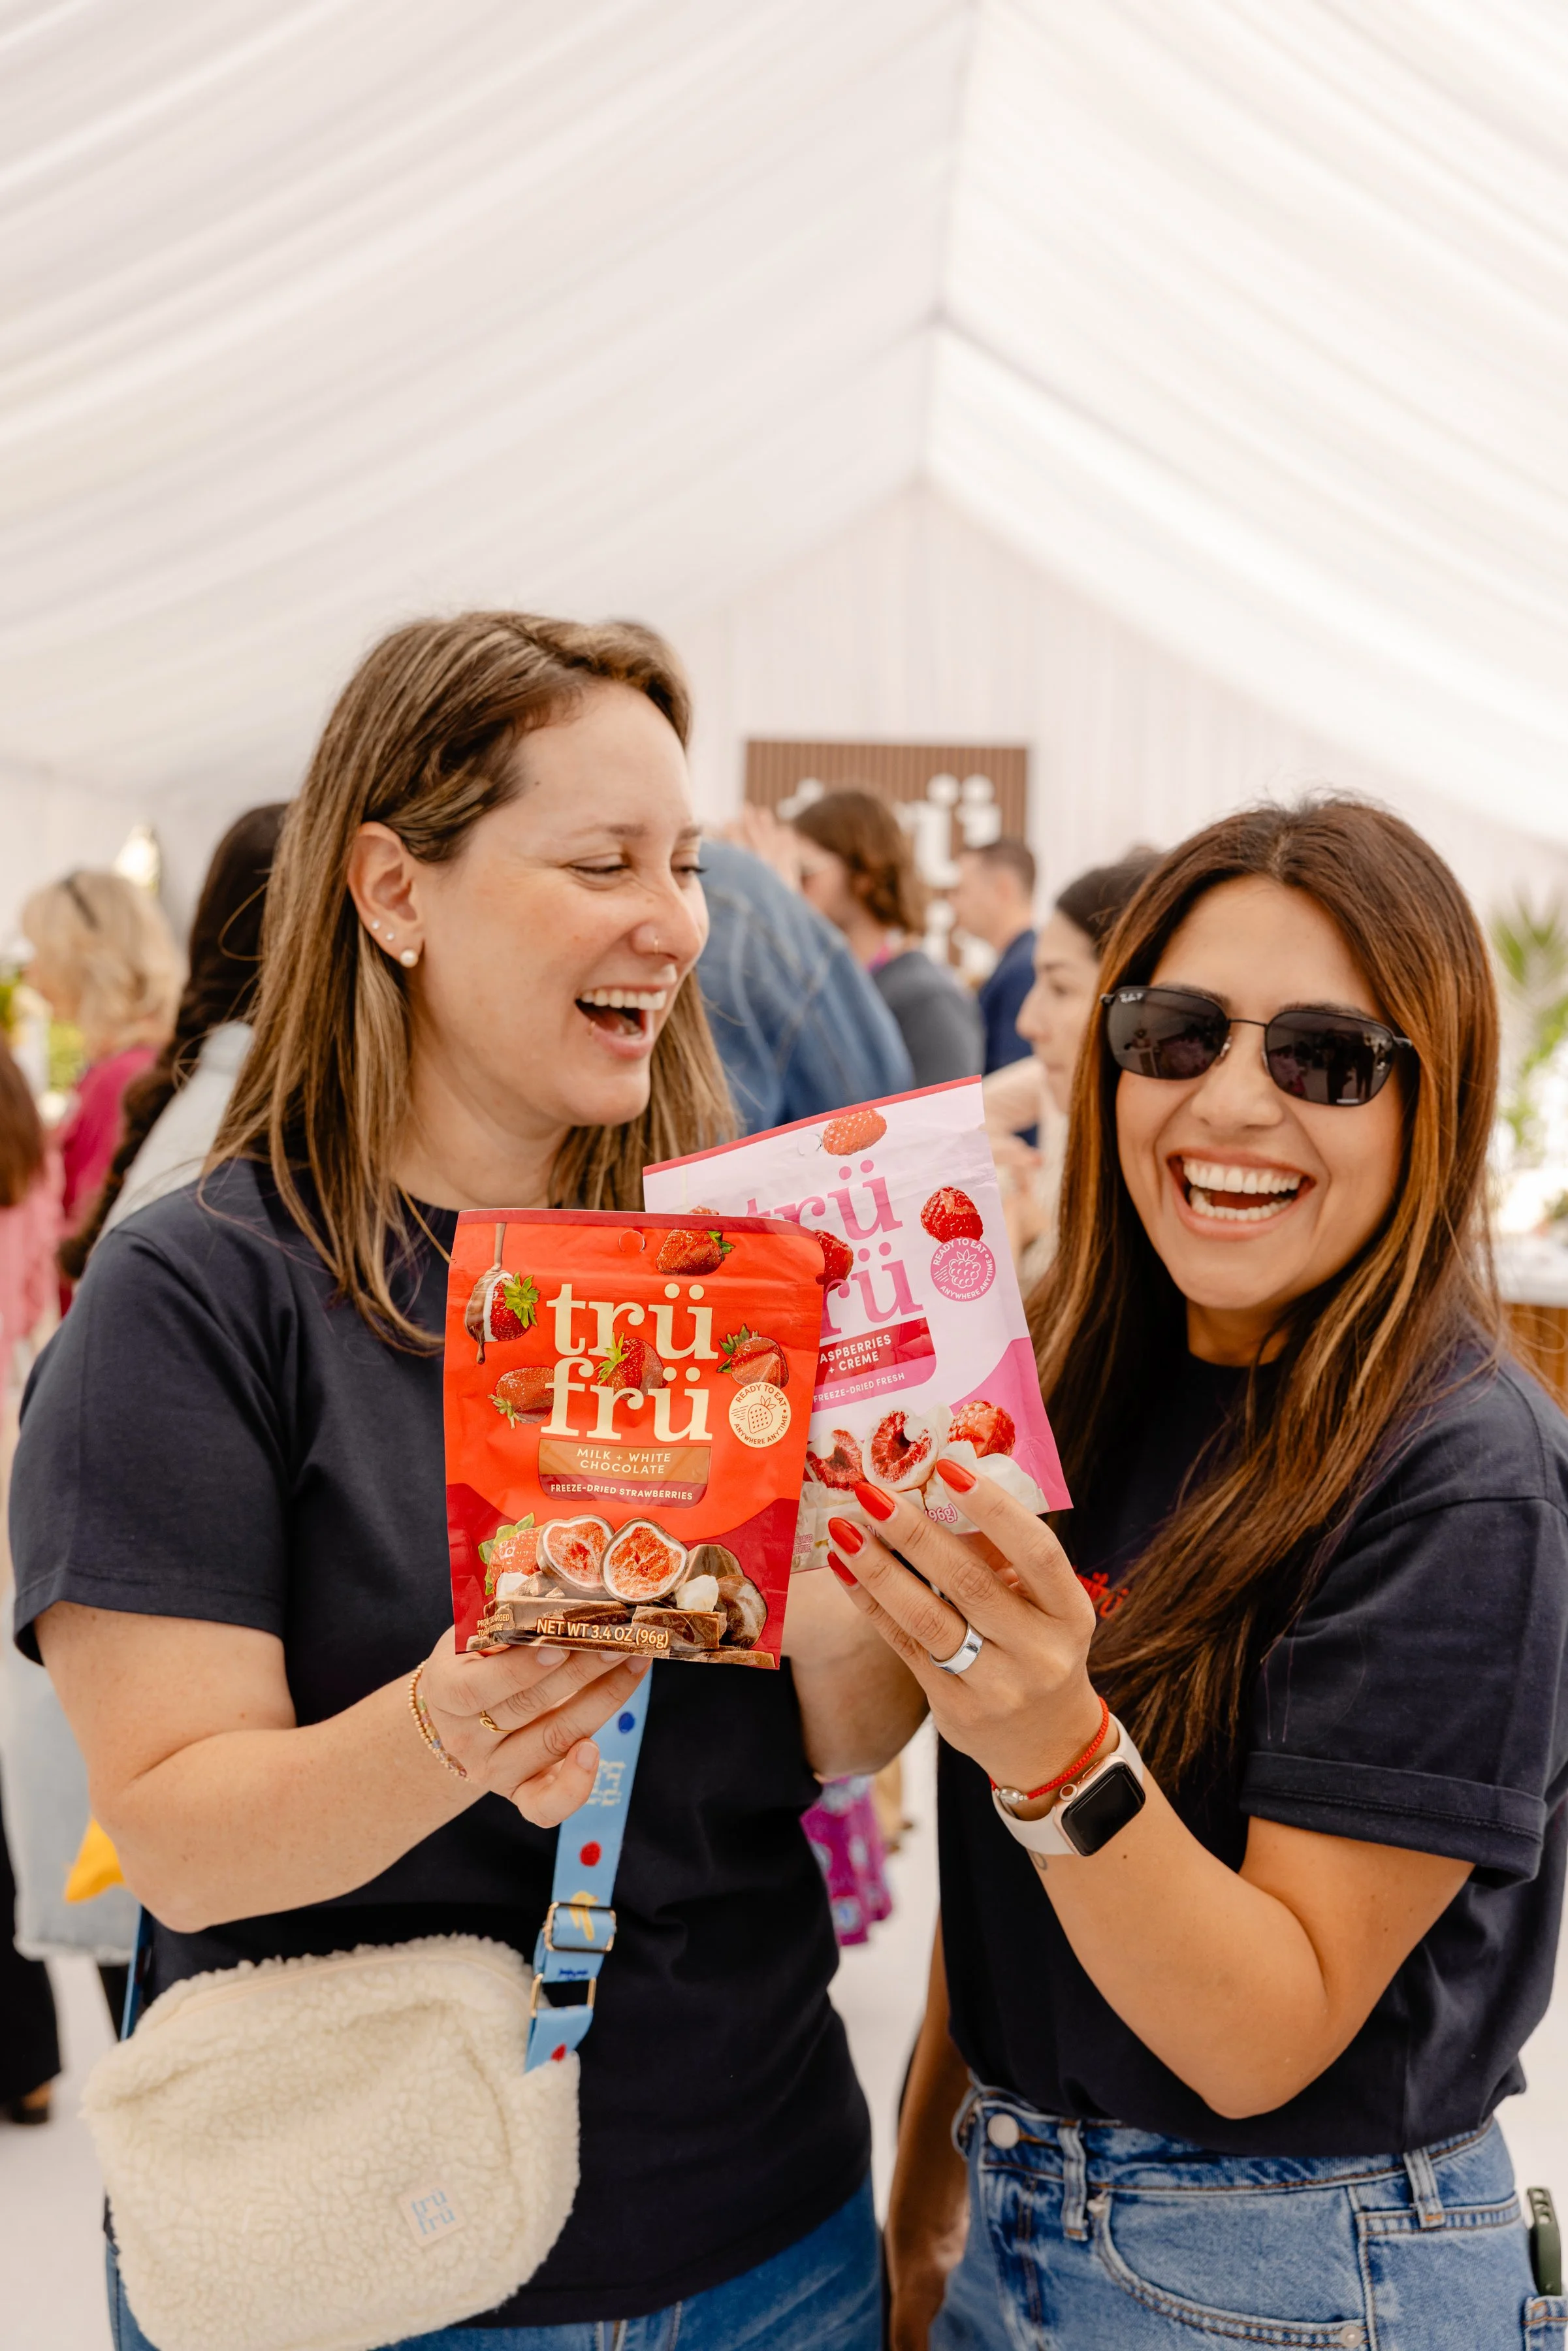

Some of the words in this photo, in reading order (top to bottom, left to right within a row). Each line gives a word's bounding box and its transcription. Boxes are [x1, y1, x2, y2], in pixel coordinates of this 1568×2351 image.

[746, 1159, 903, 1240] rü
[933, 1240, 954, 1266] READY
[970, 1240, 987, 1253] EAT
[820, 1241, 923, 1339] rü
[940, 1285, 981, 1300] ANYWHERE
[980, 1258, 993, 1292] ANYTIME
[547, 1283, 718, 1360] trü
[820, 1334, 891, 1364] ASPBERRIES
[839, 1351, 879, 1371] CREME
[540, 1357, 712, 1442] frü
[735, 1384, 761, 1403] READY
[764, 1384, 774, 1394] TO
[774, 1392, 787, 1407] EAT
[813, 1381, 874, 1403] FREEZE-DRIED
[876, 1372, 905, 1386] FRESH
[734, 1424, 765, 1445] ANYWHERE
[767, 1415, 788, 1442] ANYTIME
[577, 1448, 611, 1460] MILK
[628, 1453, 671, 1462] WHITE
[580, 1460, 665, 1474] CHOCOLATE
[551, 1484, 616, 1494] FREEZE-DRIED
[619, 1488, 693, 1500] STRAWBERRIES
[537, 1618, 565, 1635] NET
[567, 1622, 590, 1638] WT
[591, 1624, 611, 1640] 3.4
[615, 1627, 633, 1642] OZ
[635, 1628, 669, 1649] (96g)
